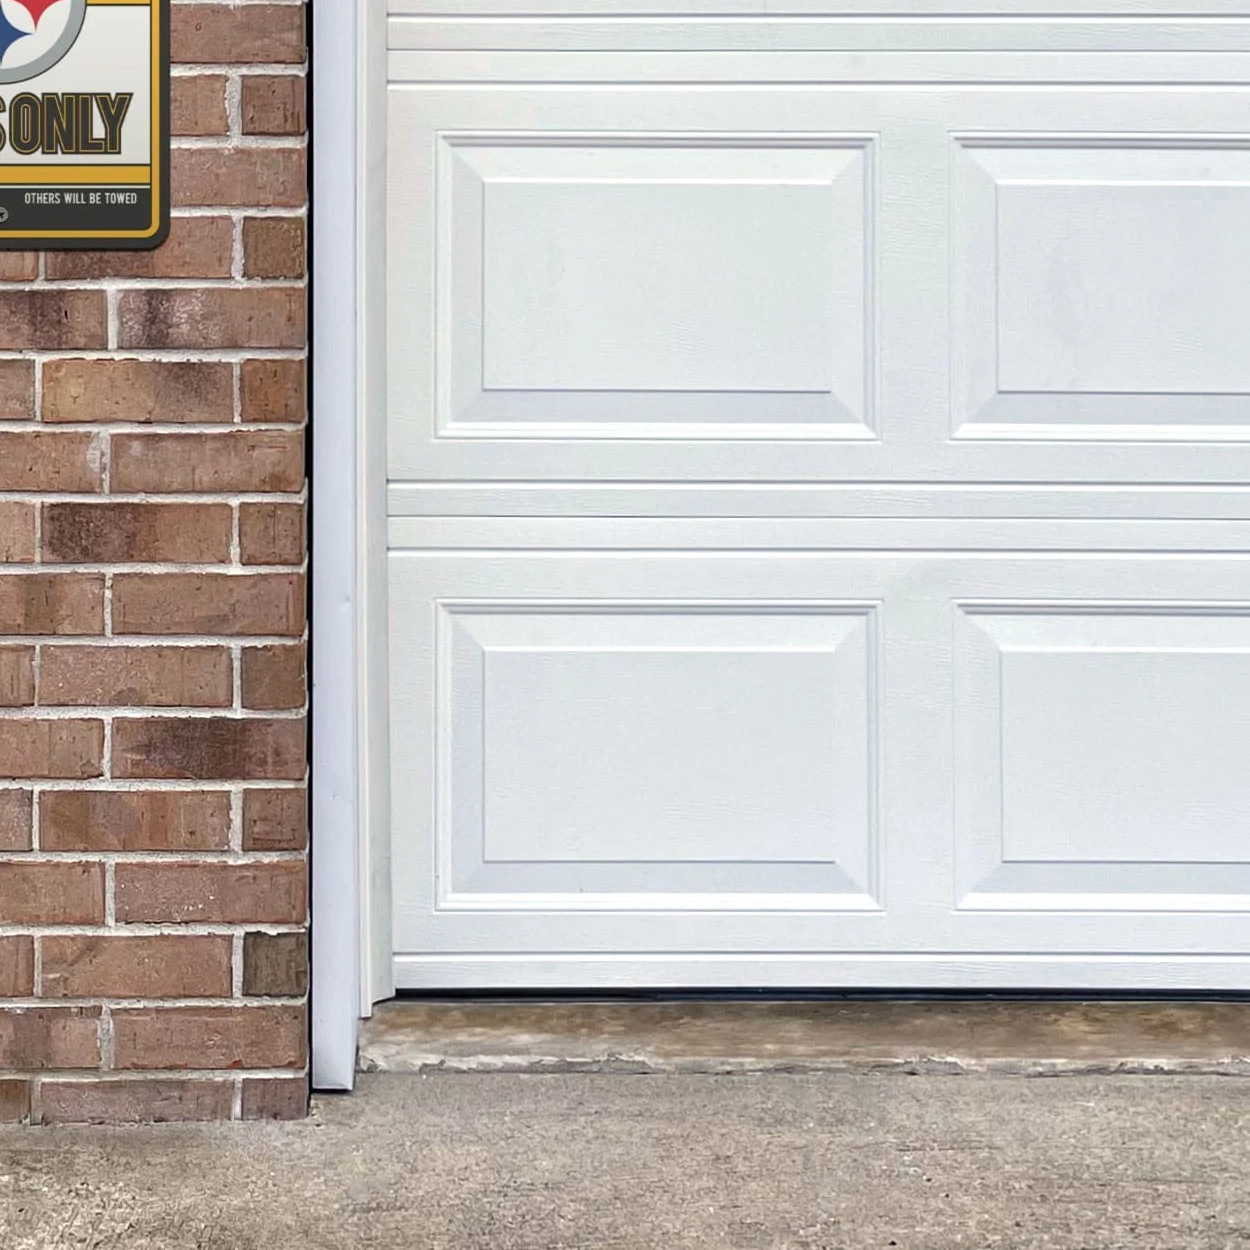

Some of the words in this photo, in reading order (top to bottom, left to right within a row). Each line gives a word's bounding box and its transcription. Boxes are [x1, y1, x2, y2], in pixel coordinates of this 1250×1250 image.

[8, 92, 134, 155] ONLY
[24, 192, 61, 205] OTHERS
[64, 192, 87, 205] WILL
[89, 192, 102, 205] BE
[104, 192, 138, 205] TOWED
